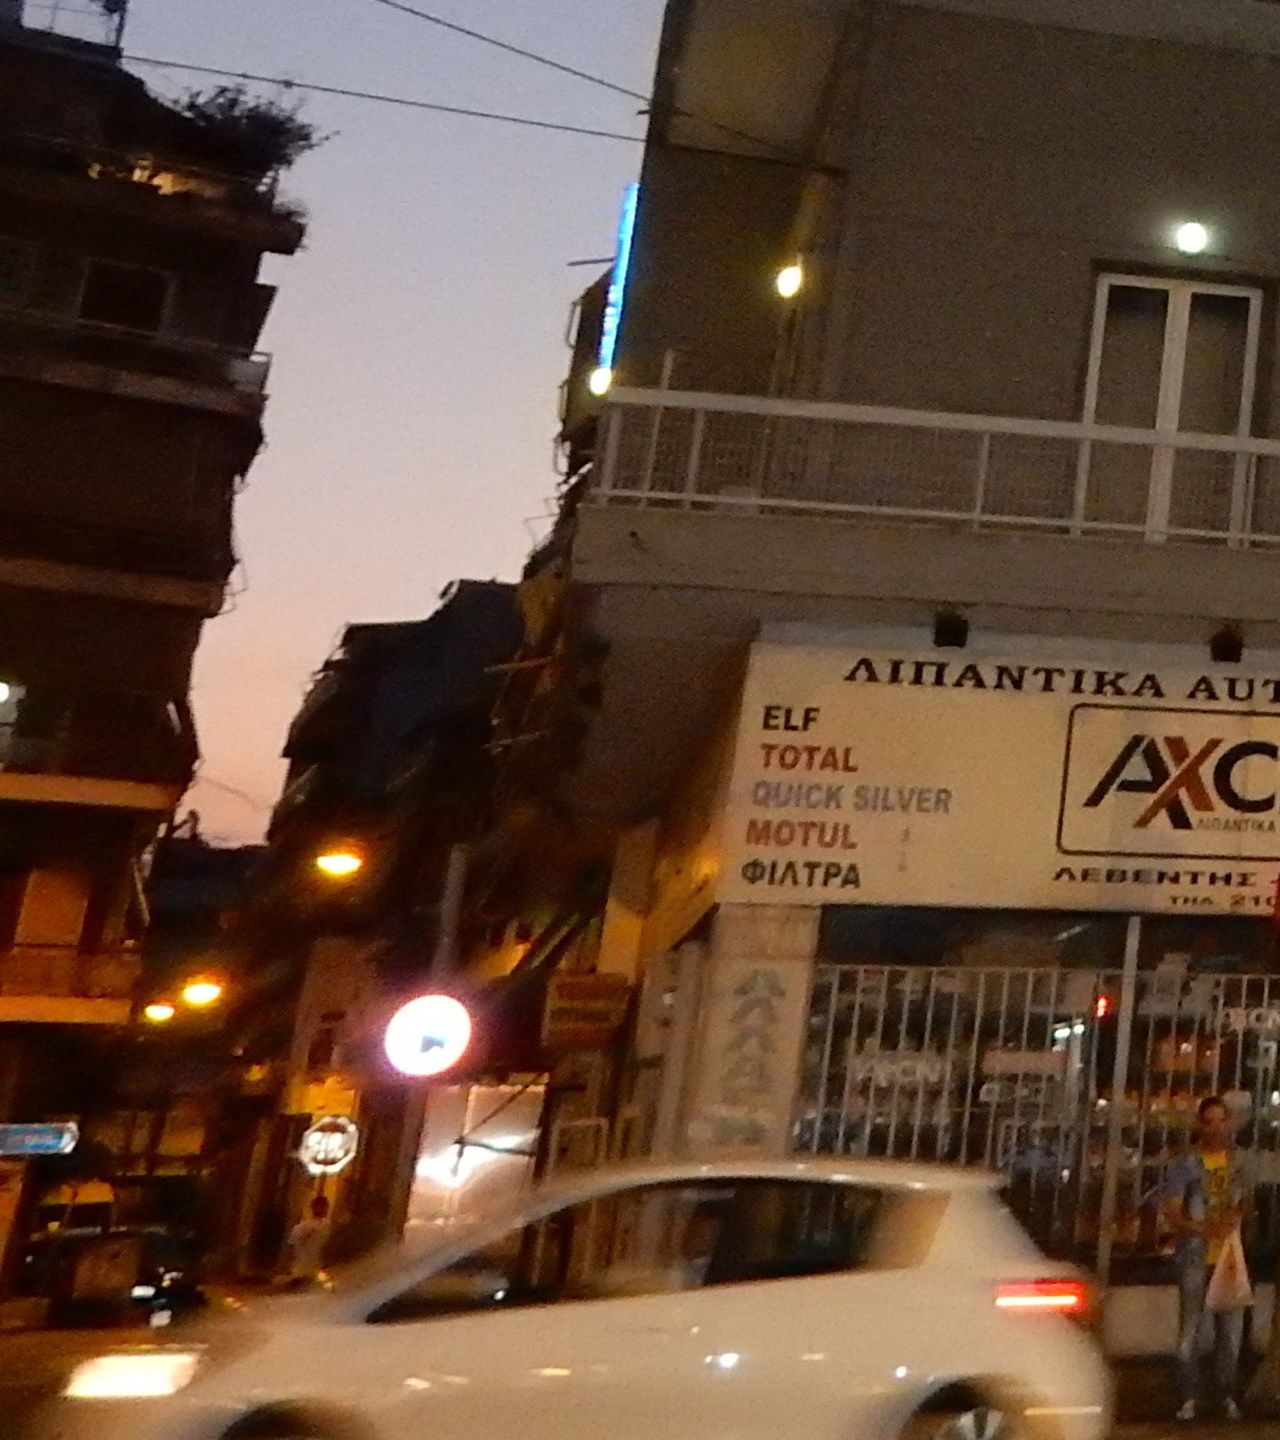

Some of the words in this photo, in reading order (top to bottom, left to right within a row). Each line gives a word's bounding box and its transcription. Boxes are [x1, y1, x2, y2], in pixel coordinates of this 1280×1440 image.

[843, 657, 1166, 700] ΛΙΠΑΝΤΙΚΑ
[762, 705, 821, 732] ELF
[760, 742, 859, 773] TOTAL
[752, 779, 845, 810] QUICK
[853, 784, 953, 814] SILVER
[745, 818, 858, 849] MOTUL
[741, 858, 861, 889] ΦΙΛΤΡΑ
